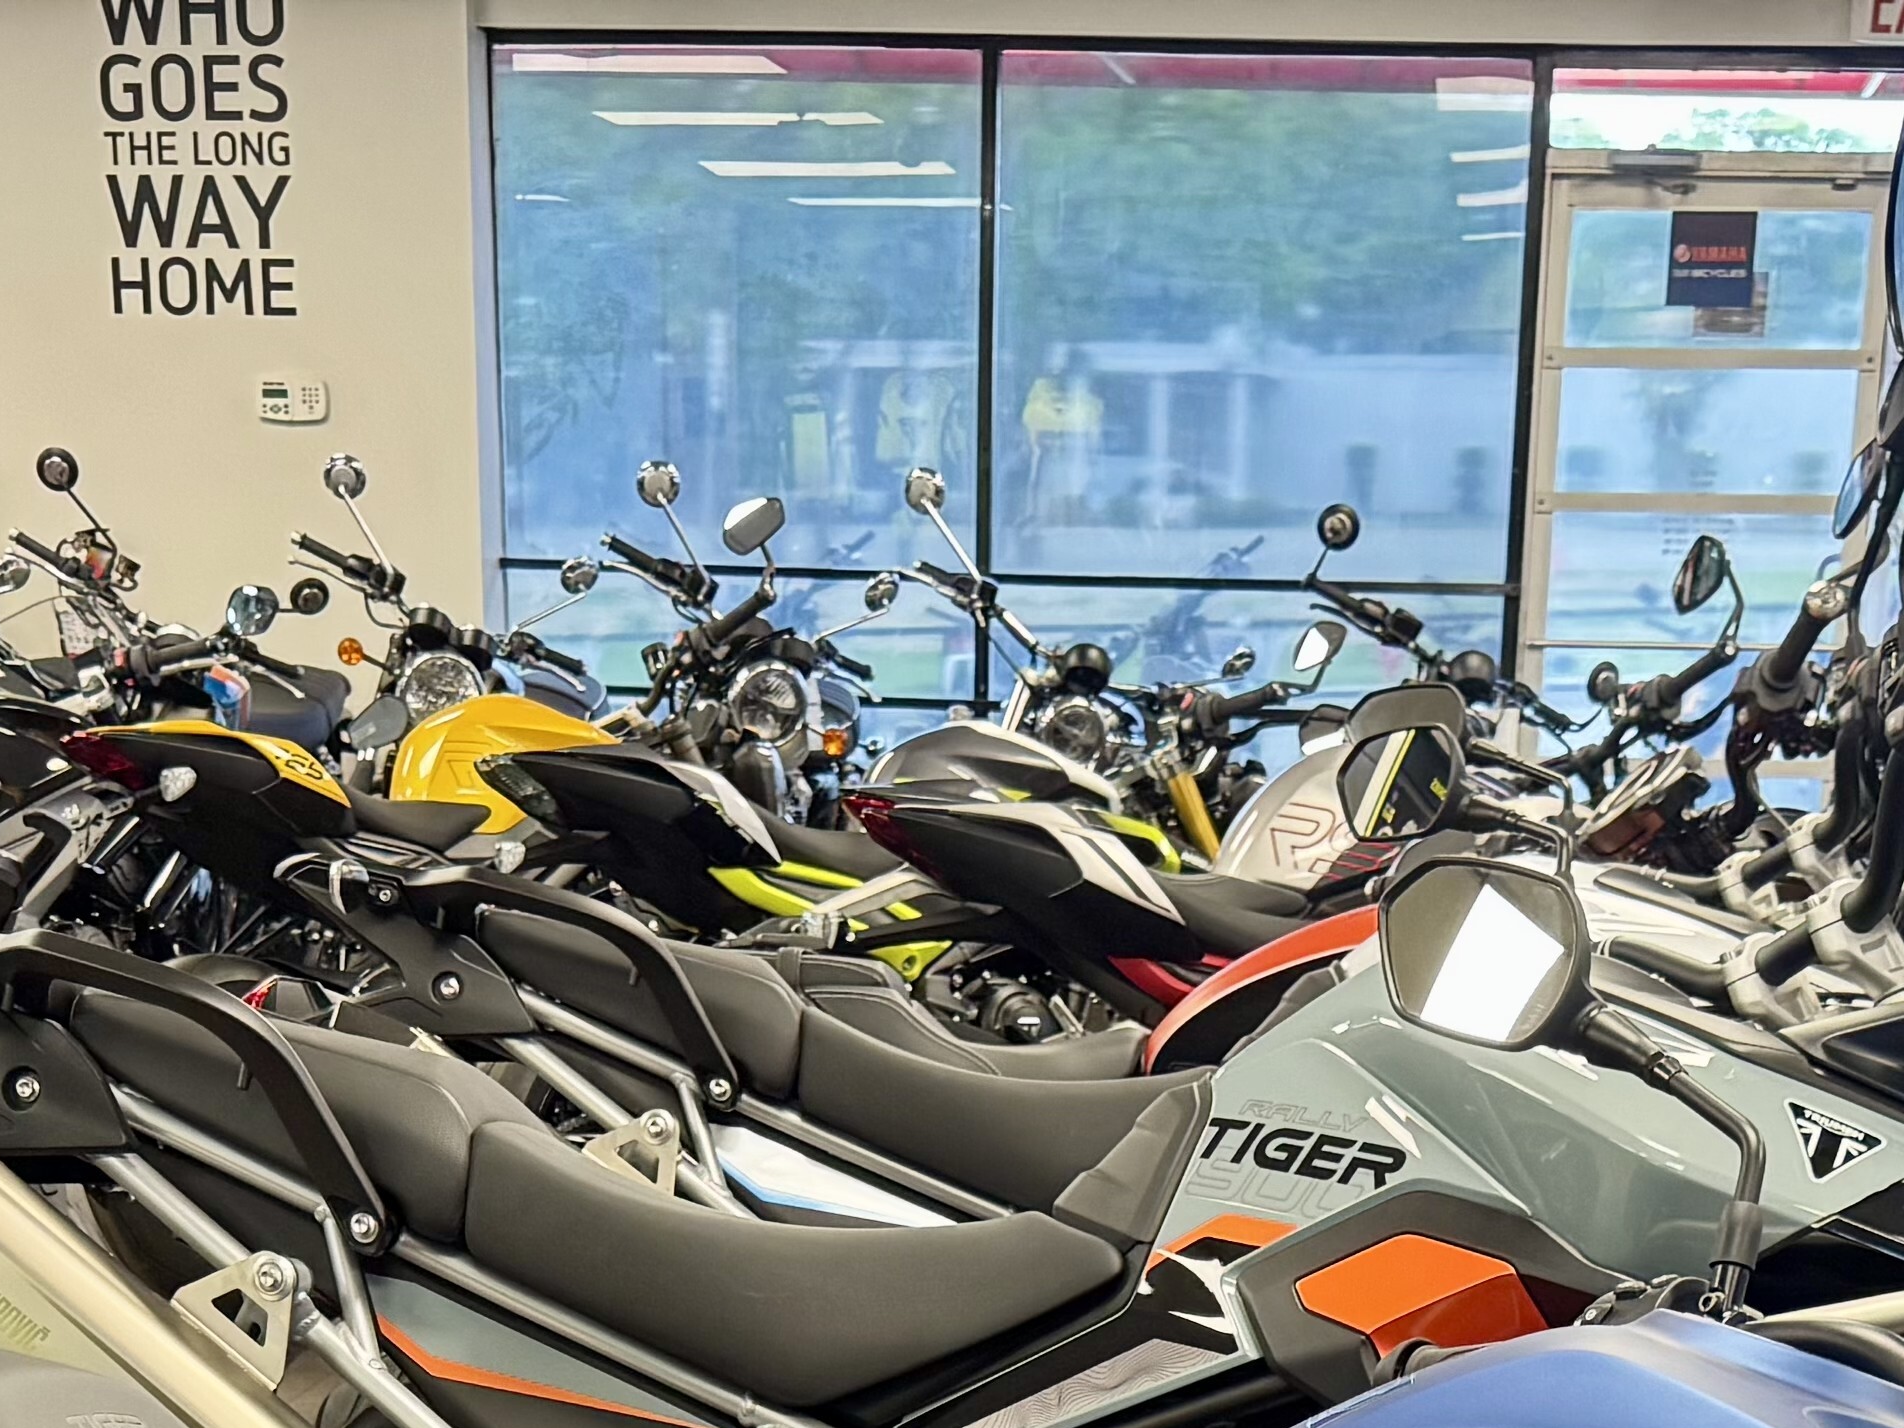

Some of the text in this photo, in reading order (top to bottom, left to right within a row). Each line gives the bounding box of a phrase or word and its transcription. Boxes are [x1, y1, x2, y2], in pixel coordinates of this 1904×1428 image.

[101, 0, 285, 47] WHO
[99, 53, 289, 123] GOES
[103, 131, 291, 166] THE LONG
[105, 174, 292, 250] WAY
[111, 256, 298, 316] HOME
[1239, 1099, 1369, 1132] RALLY
[1200, 1117, 1407, 1190] TIGER
